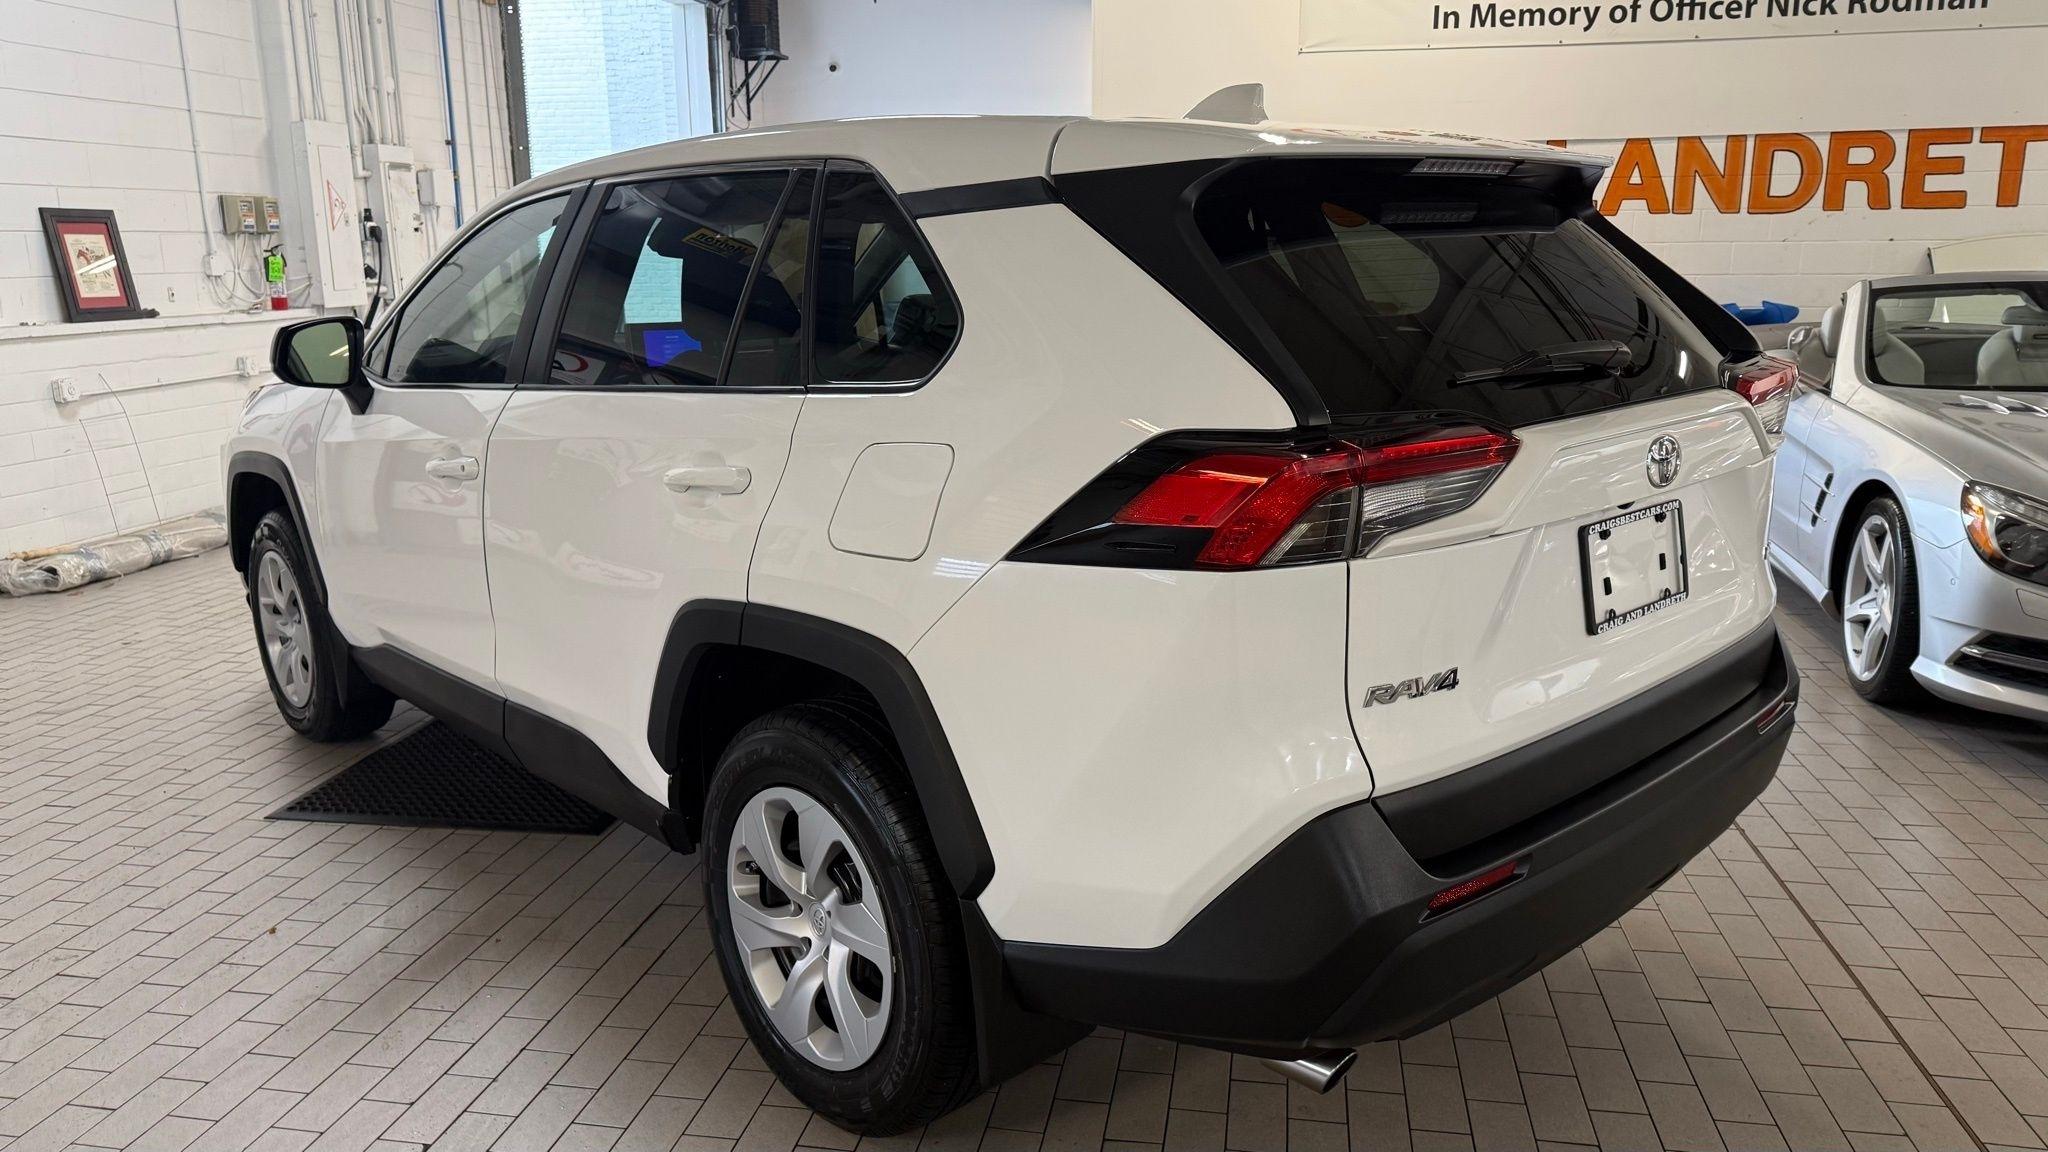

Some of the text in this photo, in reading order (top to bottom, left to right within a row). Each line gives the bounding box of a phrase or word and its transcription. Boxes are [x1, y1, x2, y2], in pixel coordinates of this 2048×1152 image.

[1433, 5, 1460, 30] In
[1470, 3, 1600, 32] Memory
[1609, 0, 1641, 24] of
[1650, 0, 1759, 22] Officer
[1766, 0, 1839, 18] Nick
[1547, 125, 2048, 216] ANDRET
[1588, 500, 1680, 535] CRAIGSBESTCARS.COM
[1597, 591, 1687, 634] CRAIG AND LANDRETH
[1362, 666, 1460, 708] RAV4
